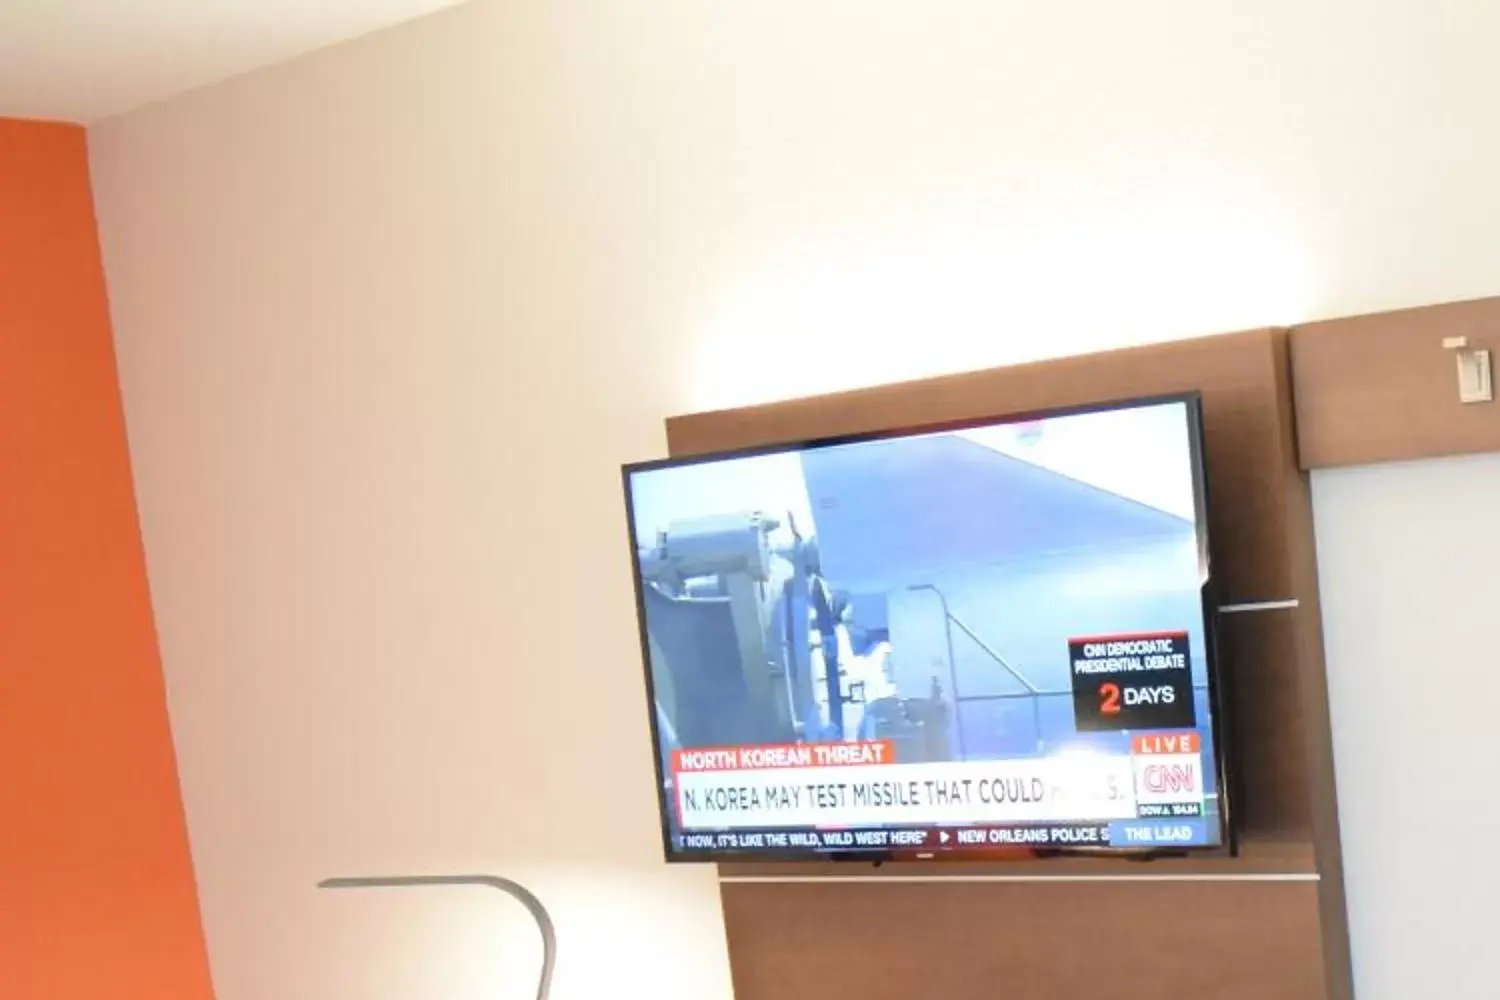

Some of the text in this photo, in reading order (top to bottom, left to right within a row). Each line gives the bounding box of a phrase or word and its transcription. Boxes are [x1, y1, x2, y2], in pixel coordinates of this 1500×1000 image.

[1107, 639, 1173, 656] DEMOCRATIC
[1075, 654, 1185, 674] PRESIDENTIAL DEBATE
[1099, 683, 1175, 713] 2 DAYS
[1141, 735, 1191, 752] LIVE
[680, 744, 884, 769] NORTH KOREAN THREAT
[1144, 764, 1195, 793] CNN
[684, 788, 701, 811] N.
[706, 787, 759, 811] KOREA
[765, 786, 800, 810] MAY
[807, 784, 846, 808] TEST
[853, 782, 920, 807] MISSILE
[925, 780, 972, 805] THAT
[979, 778, 1043, 803] COULD
[740, 833, 764, 847] LIKE
[766, 833, 789, 846] THE
[790, 832, 821, 848] WILD,
[823, 832, 852, 845] WILD
[855, 831, 887, 845] WEST
[957, 830, 986, 844] NEW
[990, 829, 1049, 843] ORLEANS
[1051, 828, 1097, 841] POLICE
[1124, 826, 1193, 841] THE LEAD
